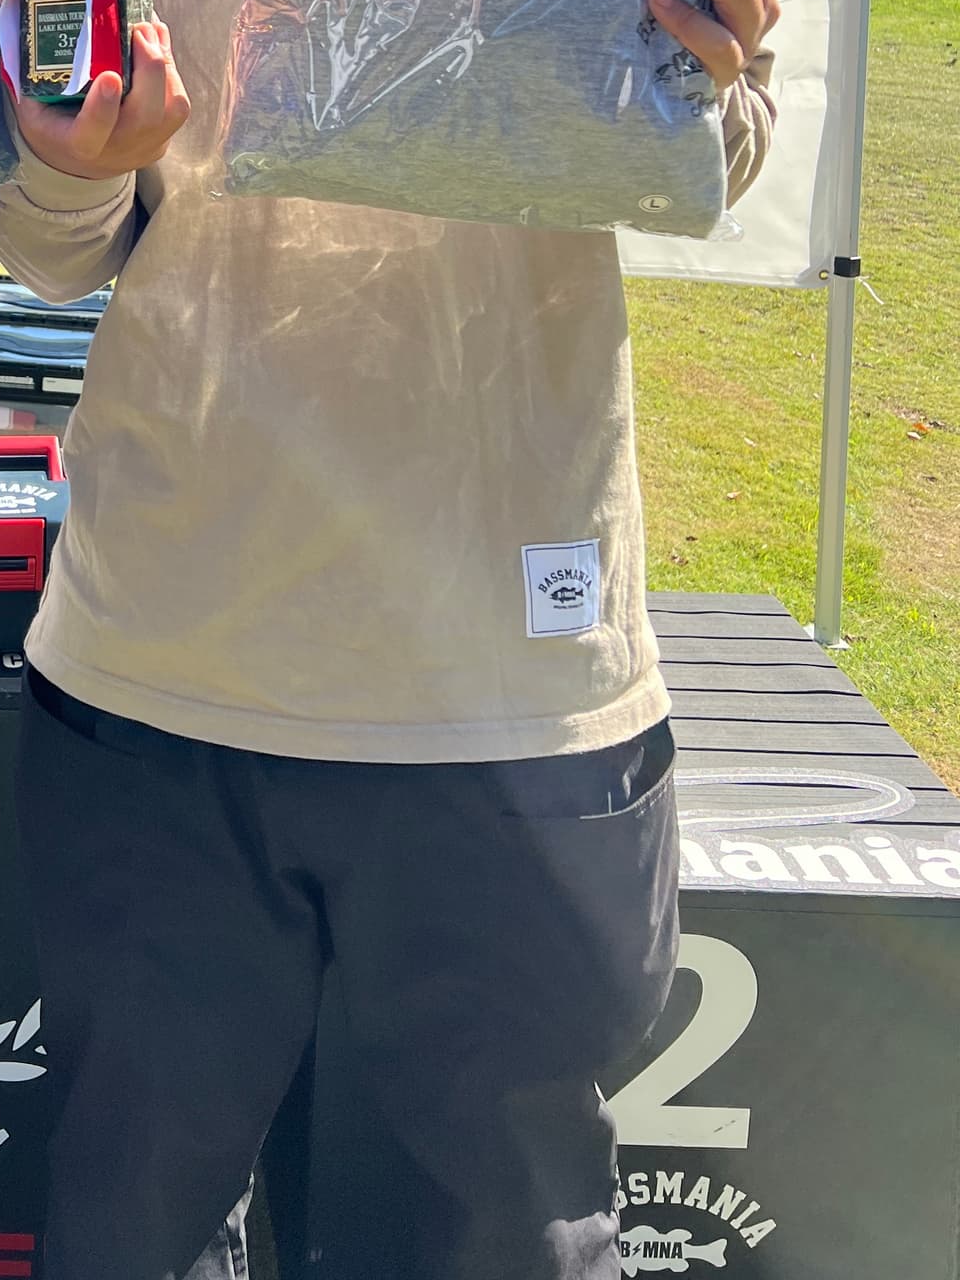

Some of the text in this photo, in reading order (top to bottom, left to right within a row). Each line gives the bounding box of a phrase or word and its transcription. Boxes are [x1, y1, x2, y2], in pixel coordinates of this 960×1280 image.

[57, 23, 81, 31] KAMEY
[58, 33, 77, 48] 3r
[538, 568, 592, 594] BASSMANIA
[607, 934, 758, 1149] 2
[617, 1171, 777, 1249] SMANIA
